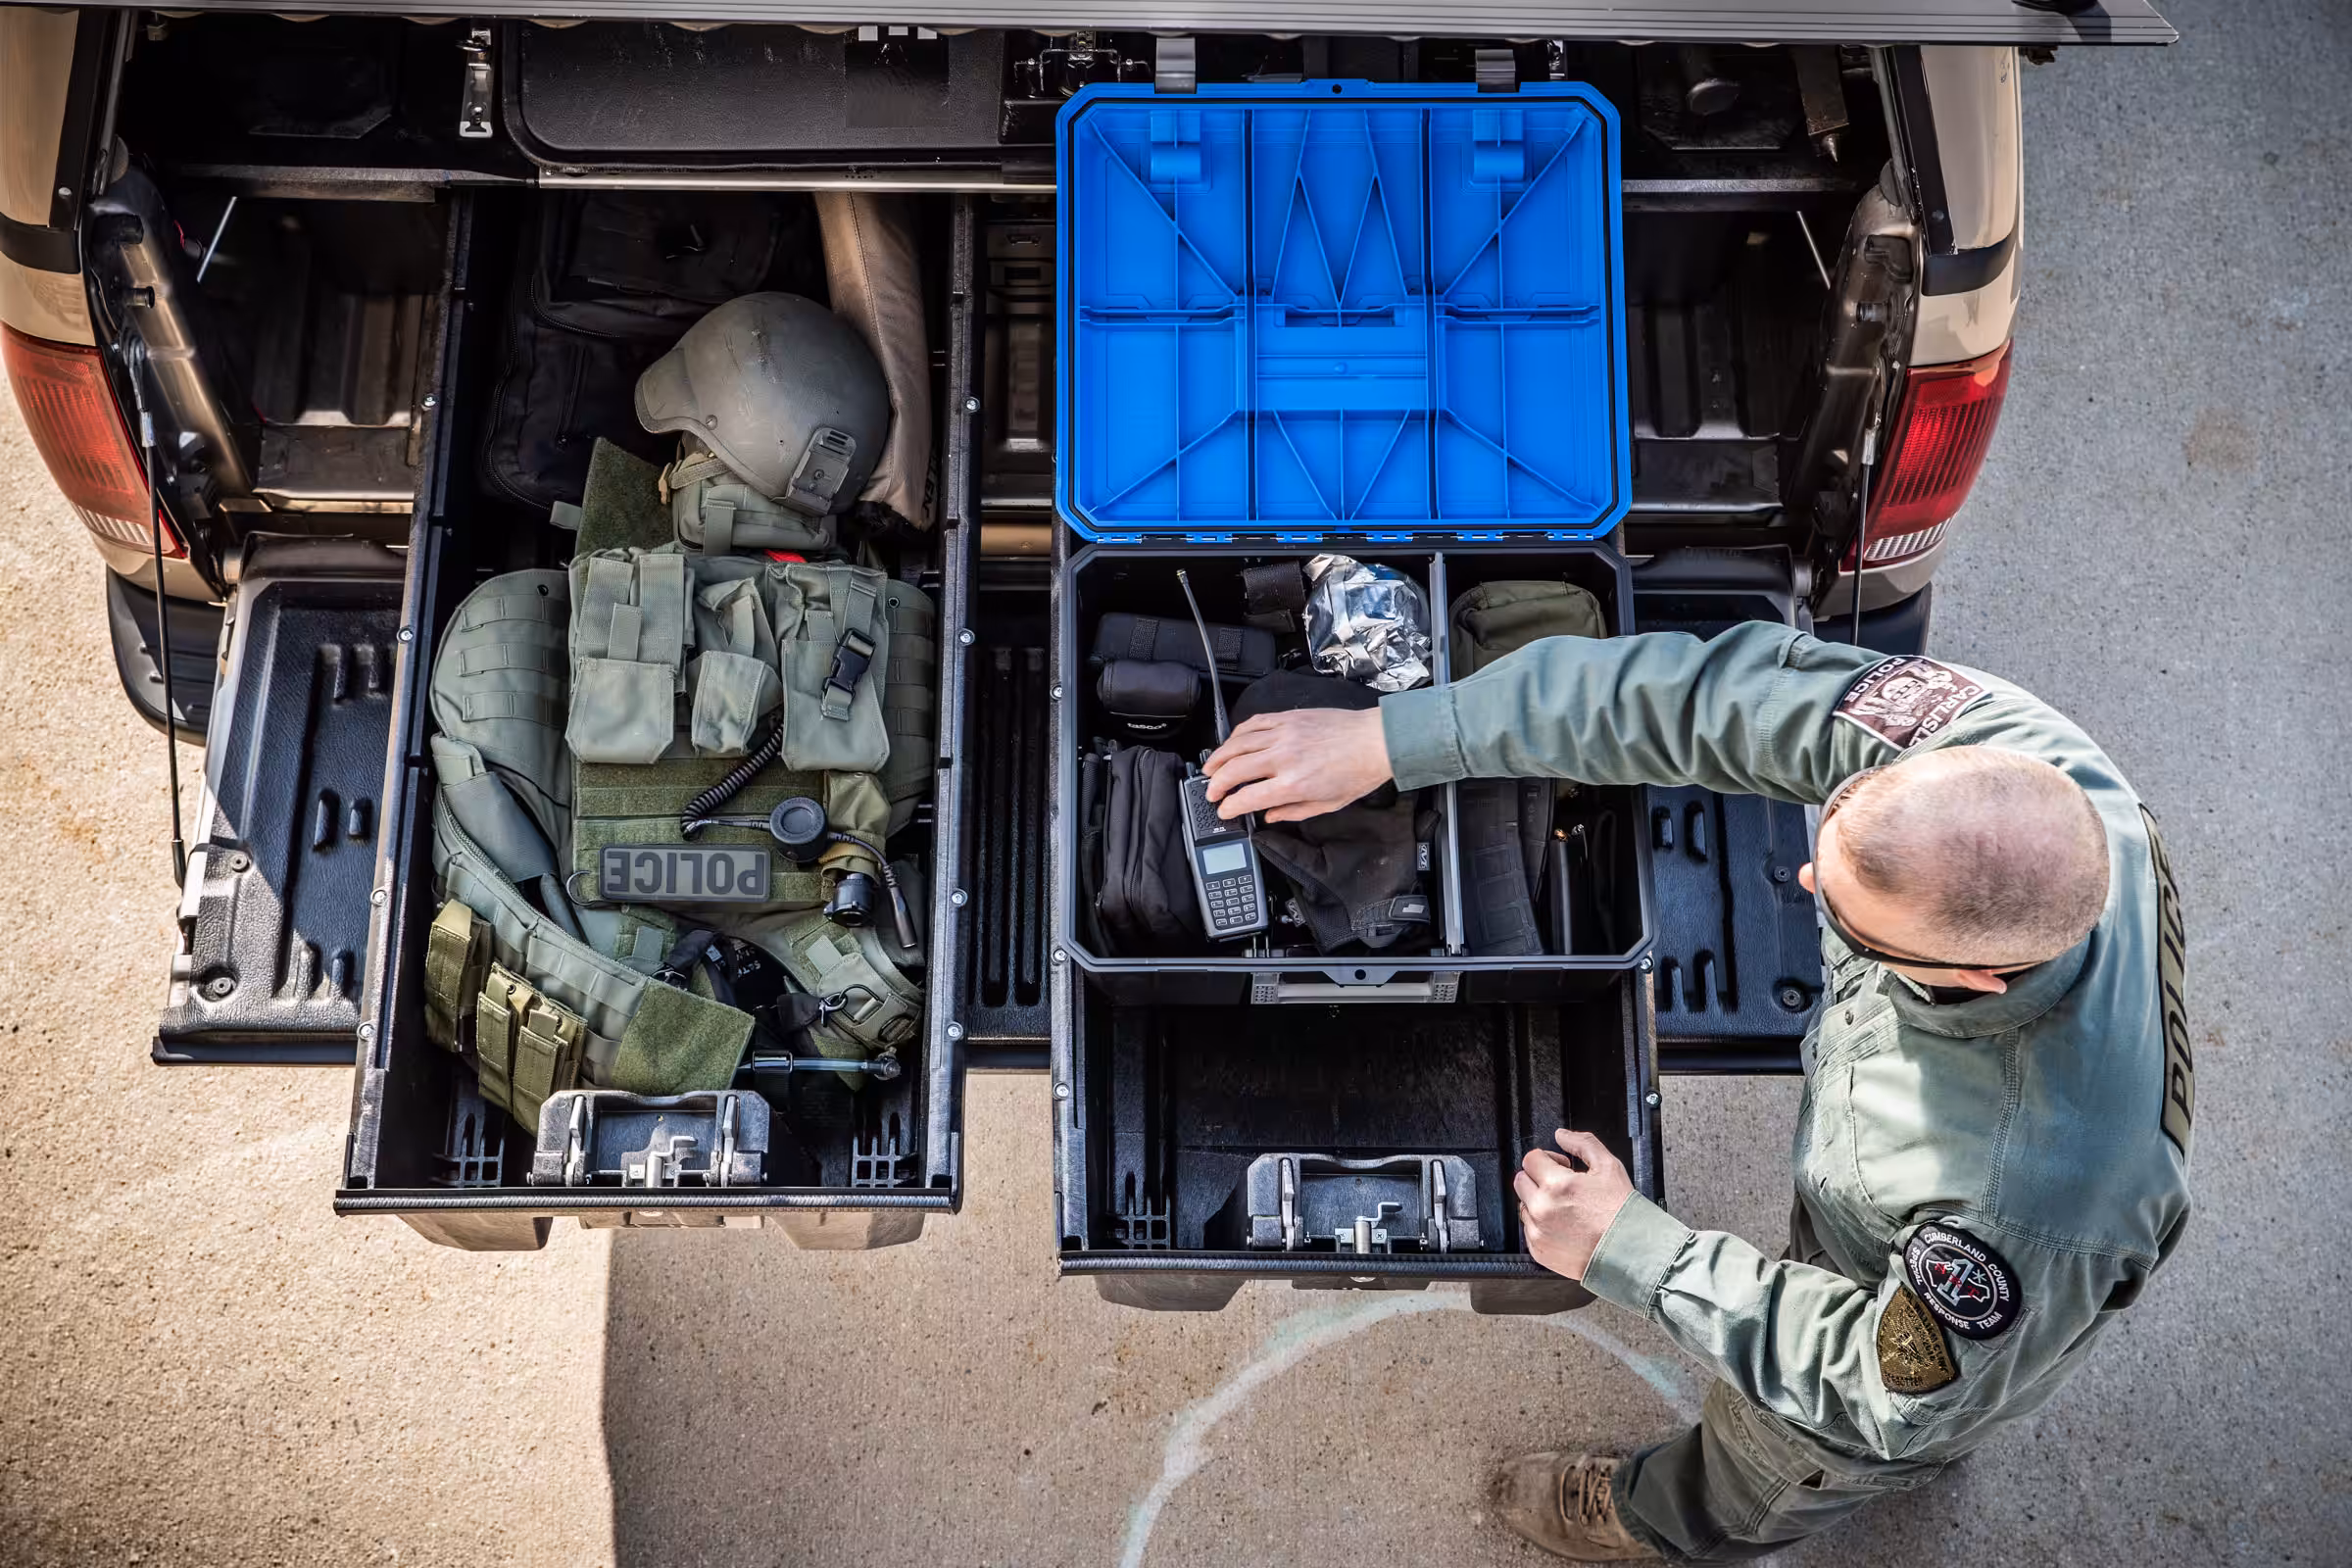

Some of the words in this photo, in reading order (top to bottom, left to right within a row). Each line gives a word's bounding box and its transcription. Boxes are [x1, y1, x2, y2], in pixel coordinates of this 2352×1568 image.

[1844, 658, 1906, 703] POLICE
[607, 851, 765, 896] POLICE
[1909, 1247, 1924, 1286] SPECIAL
[1923, 1292, 1971, 1330] RESPONSE
[1976, 1311, 2003, 1330] TEAM
[1924, 1232, 1986, 1262] CUMBERLAND
[1987, 1263, 2010, 1302] COUNTY
